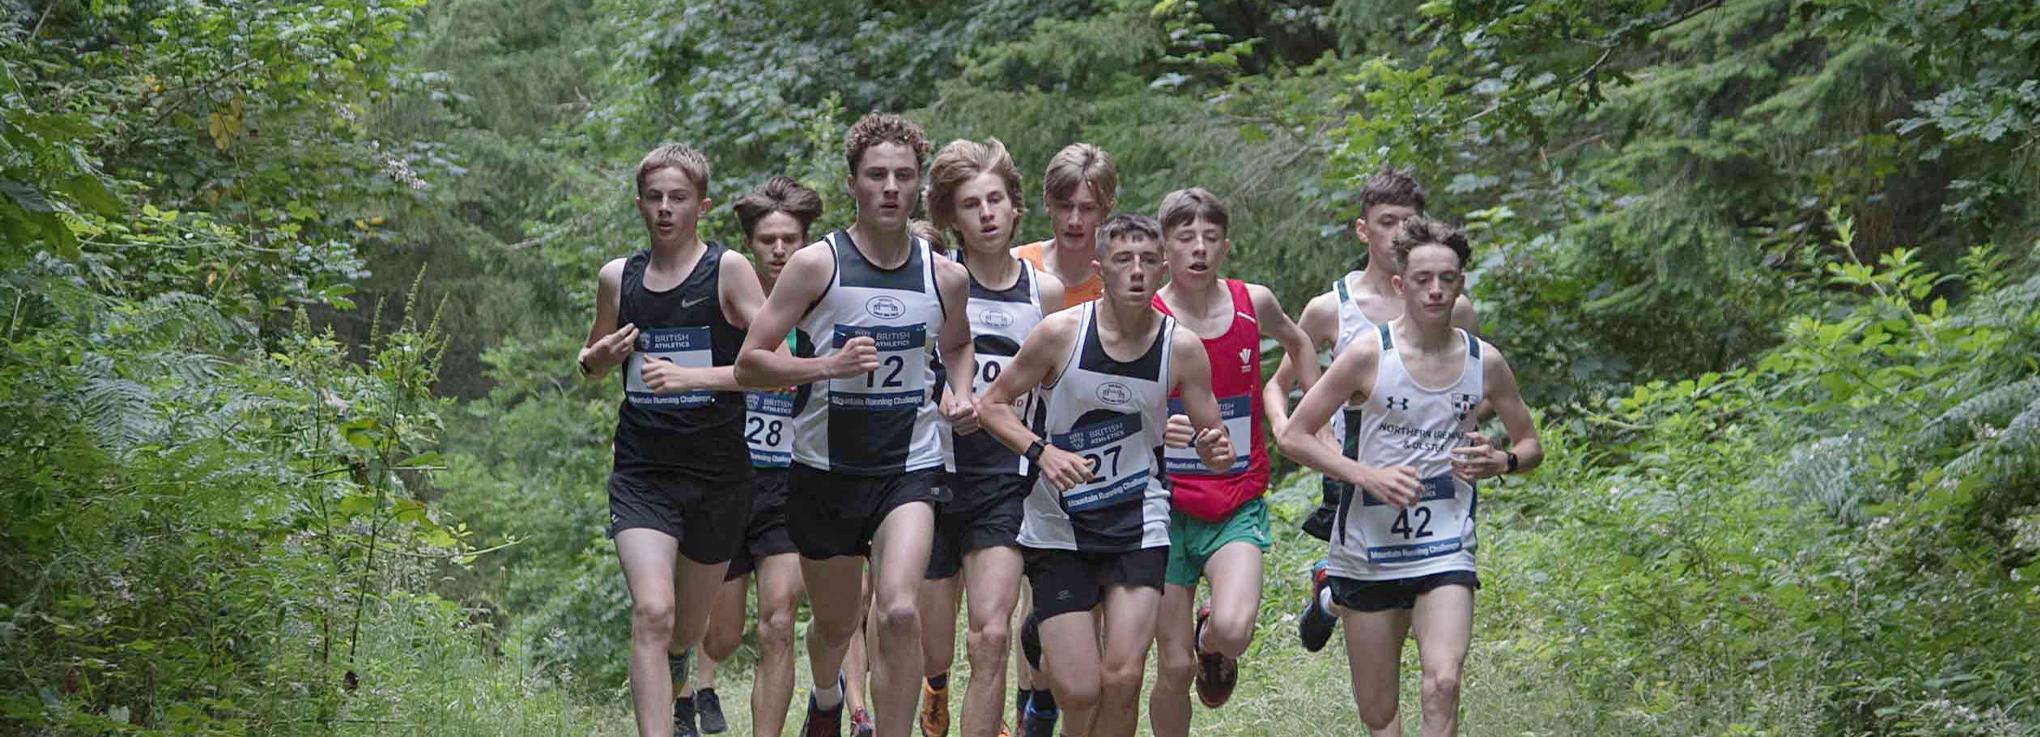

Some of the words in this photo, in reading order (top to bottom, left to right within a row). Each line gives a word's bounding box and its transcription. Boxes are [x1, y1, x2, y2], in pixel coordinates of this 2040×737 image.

[654, 333, 690, 342] BRITISH
[876, 332, 911, 341] BRITISH
[865, 396, 893, 407] Running
[745, 416, 783, 447] 28
[1088, 421, 1124, 438] BRITISH
[1379, 422, 1432, 438] NORTHERN
[1403, 440, 1411, 450] &
[1083, 445, 1122, 485] 27
[1166, 460, 1196, 470] Mountain
[1067, 493, 1099, 507] Mountain
[1098, 484, 1124, 501] Running
[1390, 505, 1434, 540] 42
[1370, 550, 1402, 559] Mountain
[1402, 547, 1429, 557] Running
